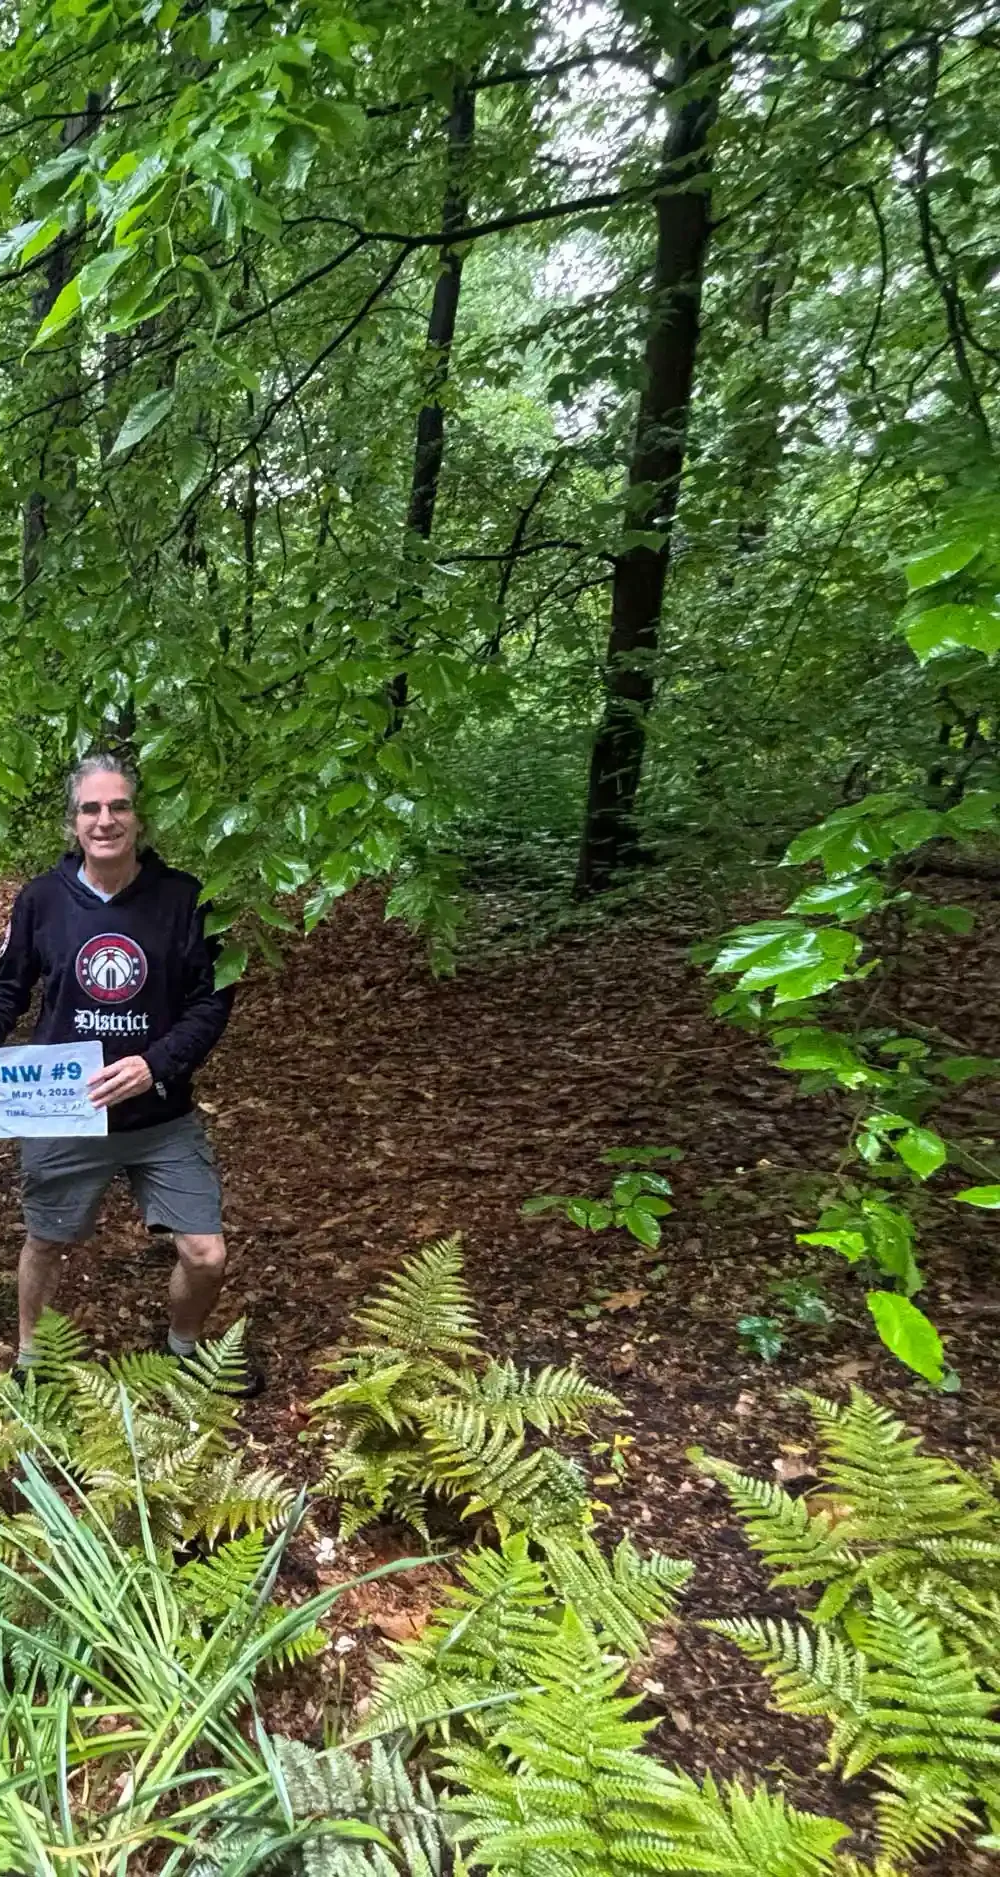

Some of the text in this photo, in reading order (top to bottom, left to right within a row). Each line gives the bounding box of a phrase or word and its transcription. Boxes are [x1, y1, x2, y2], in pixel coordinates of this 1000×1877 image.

[74, 1008, 150, 1032] District
[1, 1061, 83, 1084] NW #9
[11, 1090, 33, 1100] May
[36, 1088, 47, 1098] 4,
